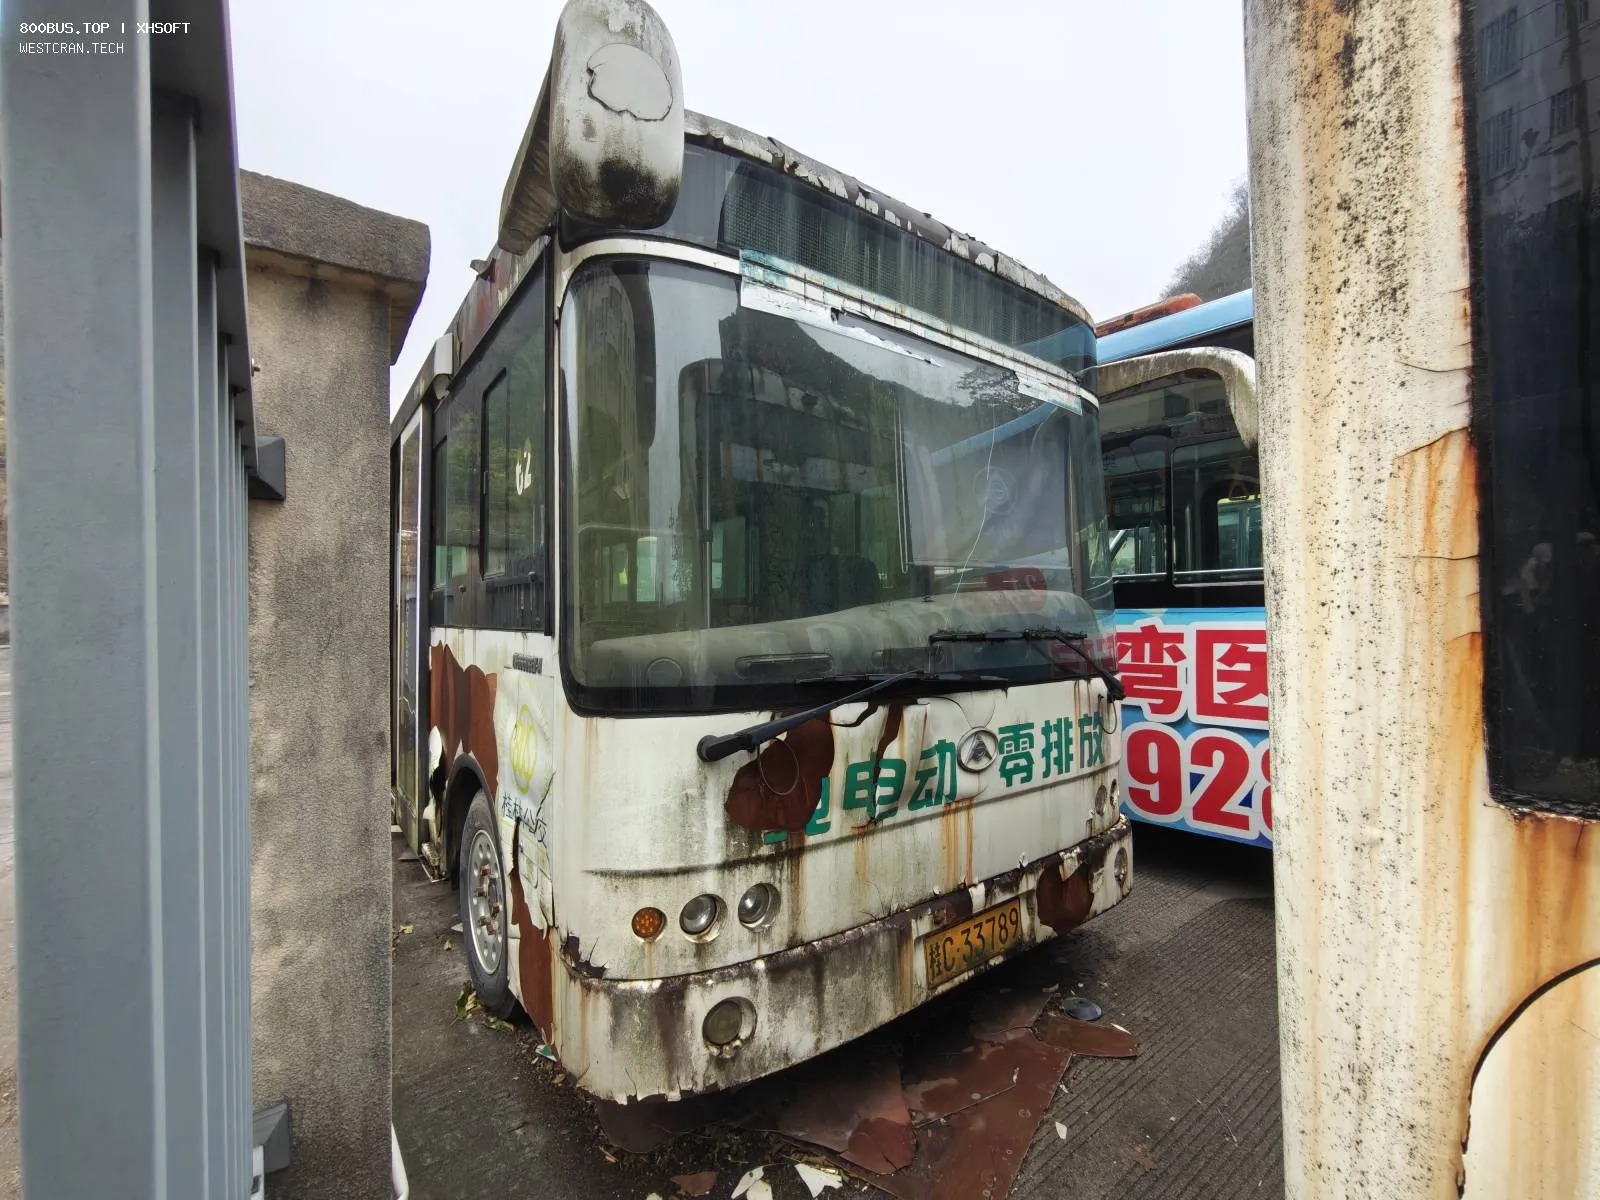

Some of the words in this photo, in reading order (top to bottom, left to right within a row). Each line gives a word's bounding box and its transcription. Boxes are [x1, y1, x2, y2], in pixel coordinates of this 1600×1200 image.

[998, 711, 1105, 788] 零排放
[1127, 729, 1273, 832] 92
